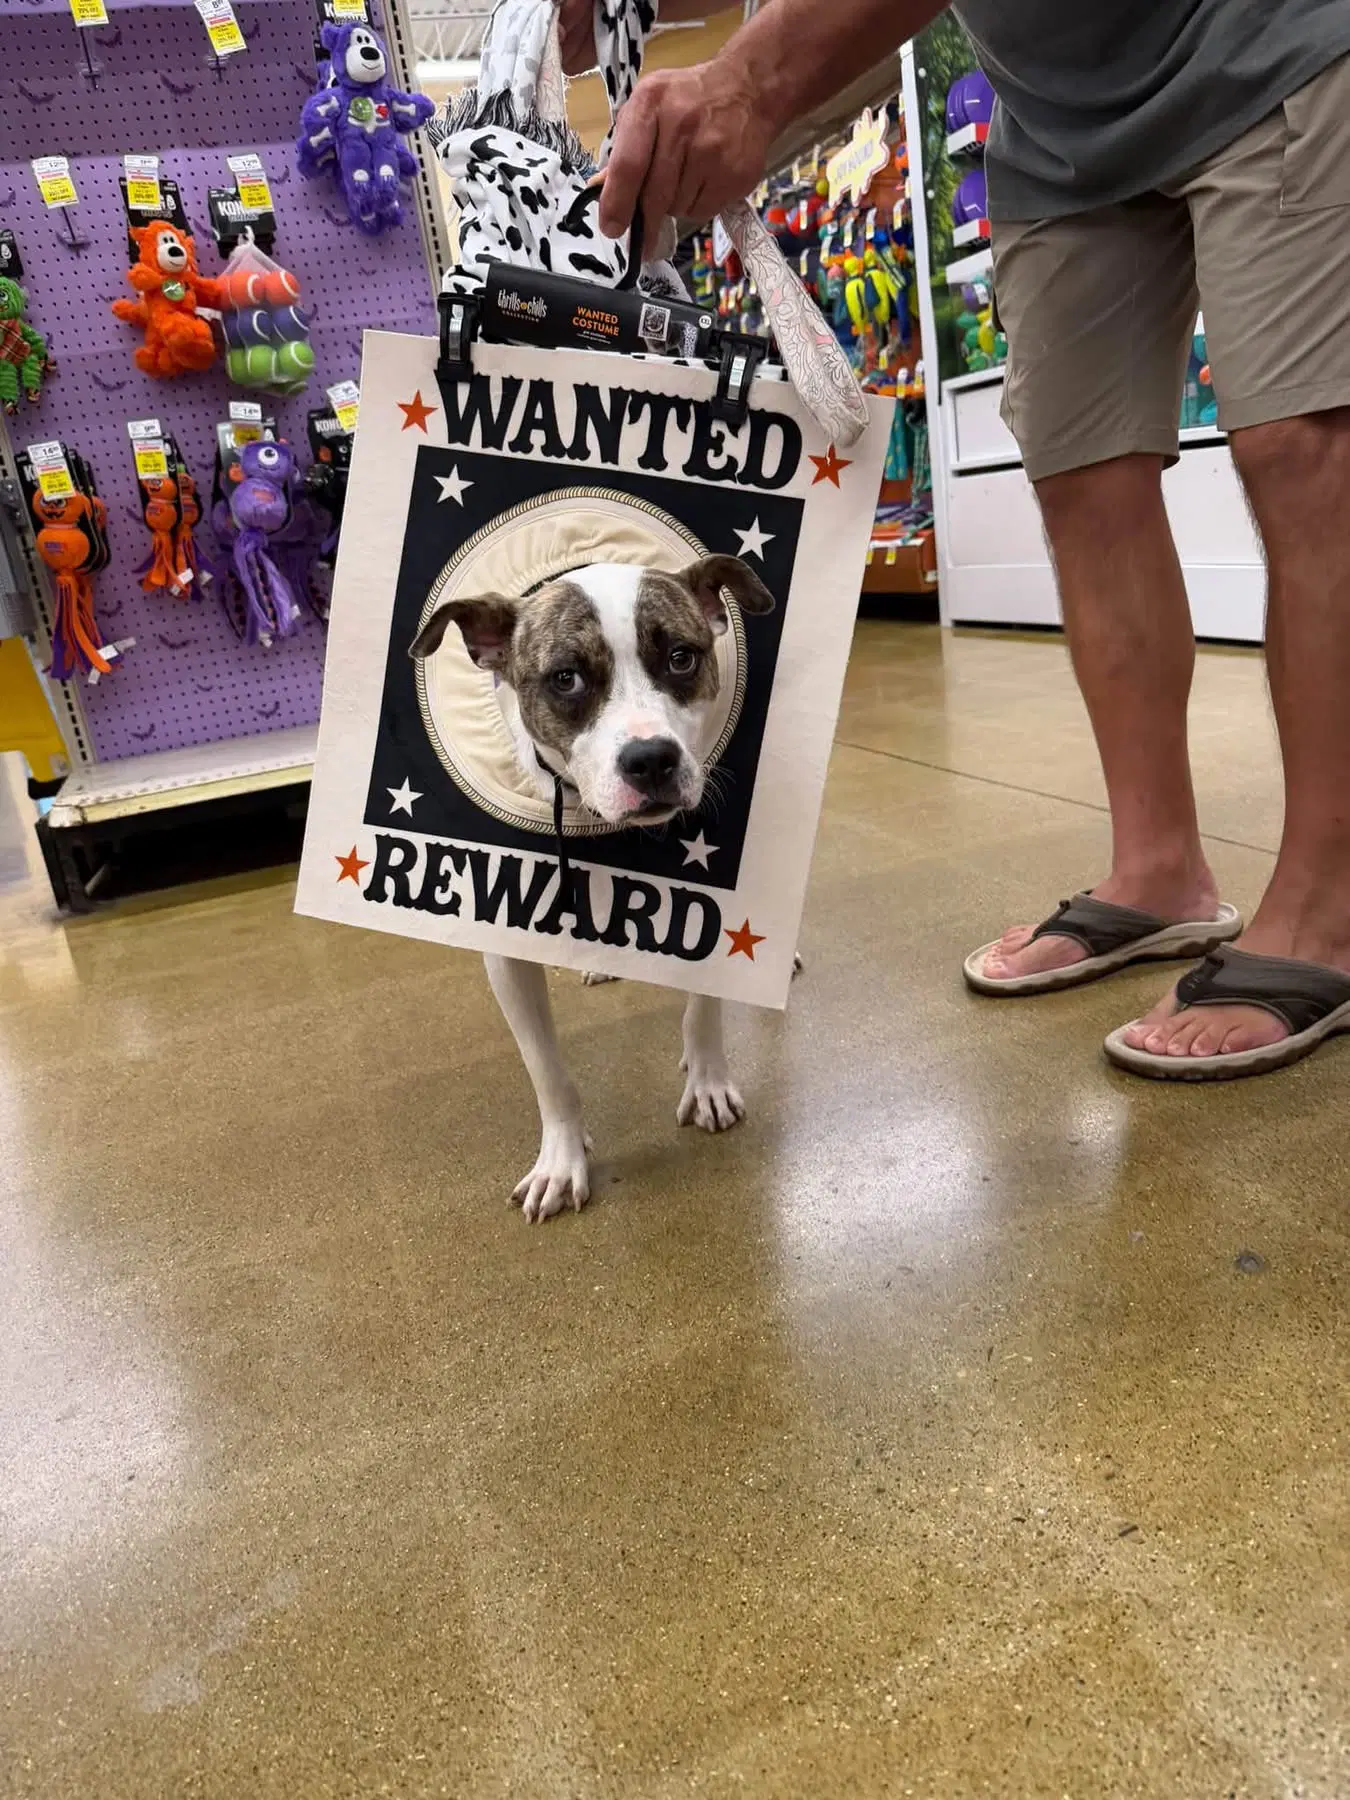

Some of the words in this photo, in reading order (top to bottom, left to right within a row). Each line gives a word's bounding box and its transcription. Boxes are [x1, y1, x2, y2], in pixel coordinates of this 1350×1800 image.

[217, 200, 247, 217] KON
[576, 305, 618, 325] WANTED
[572, 316, 620, 337] COSTUME
[434, 369, 802, 490] WANTED
[363, 834, 721, 961] REWARD
